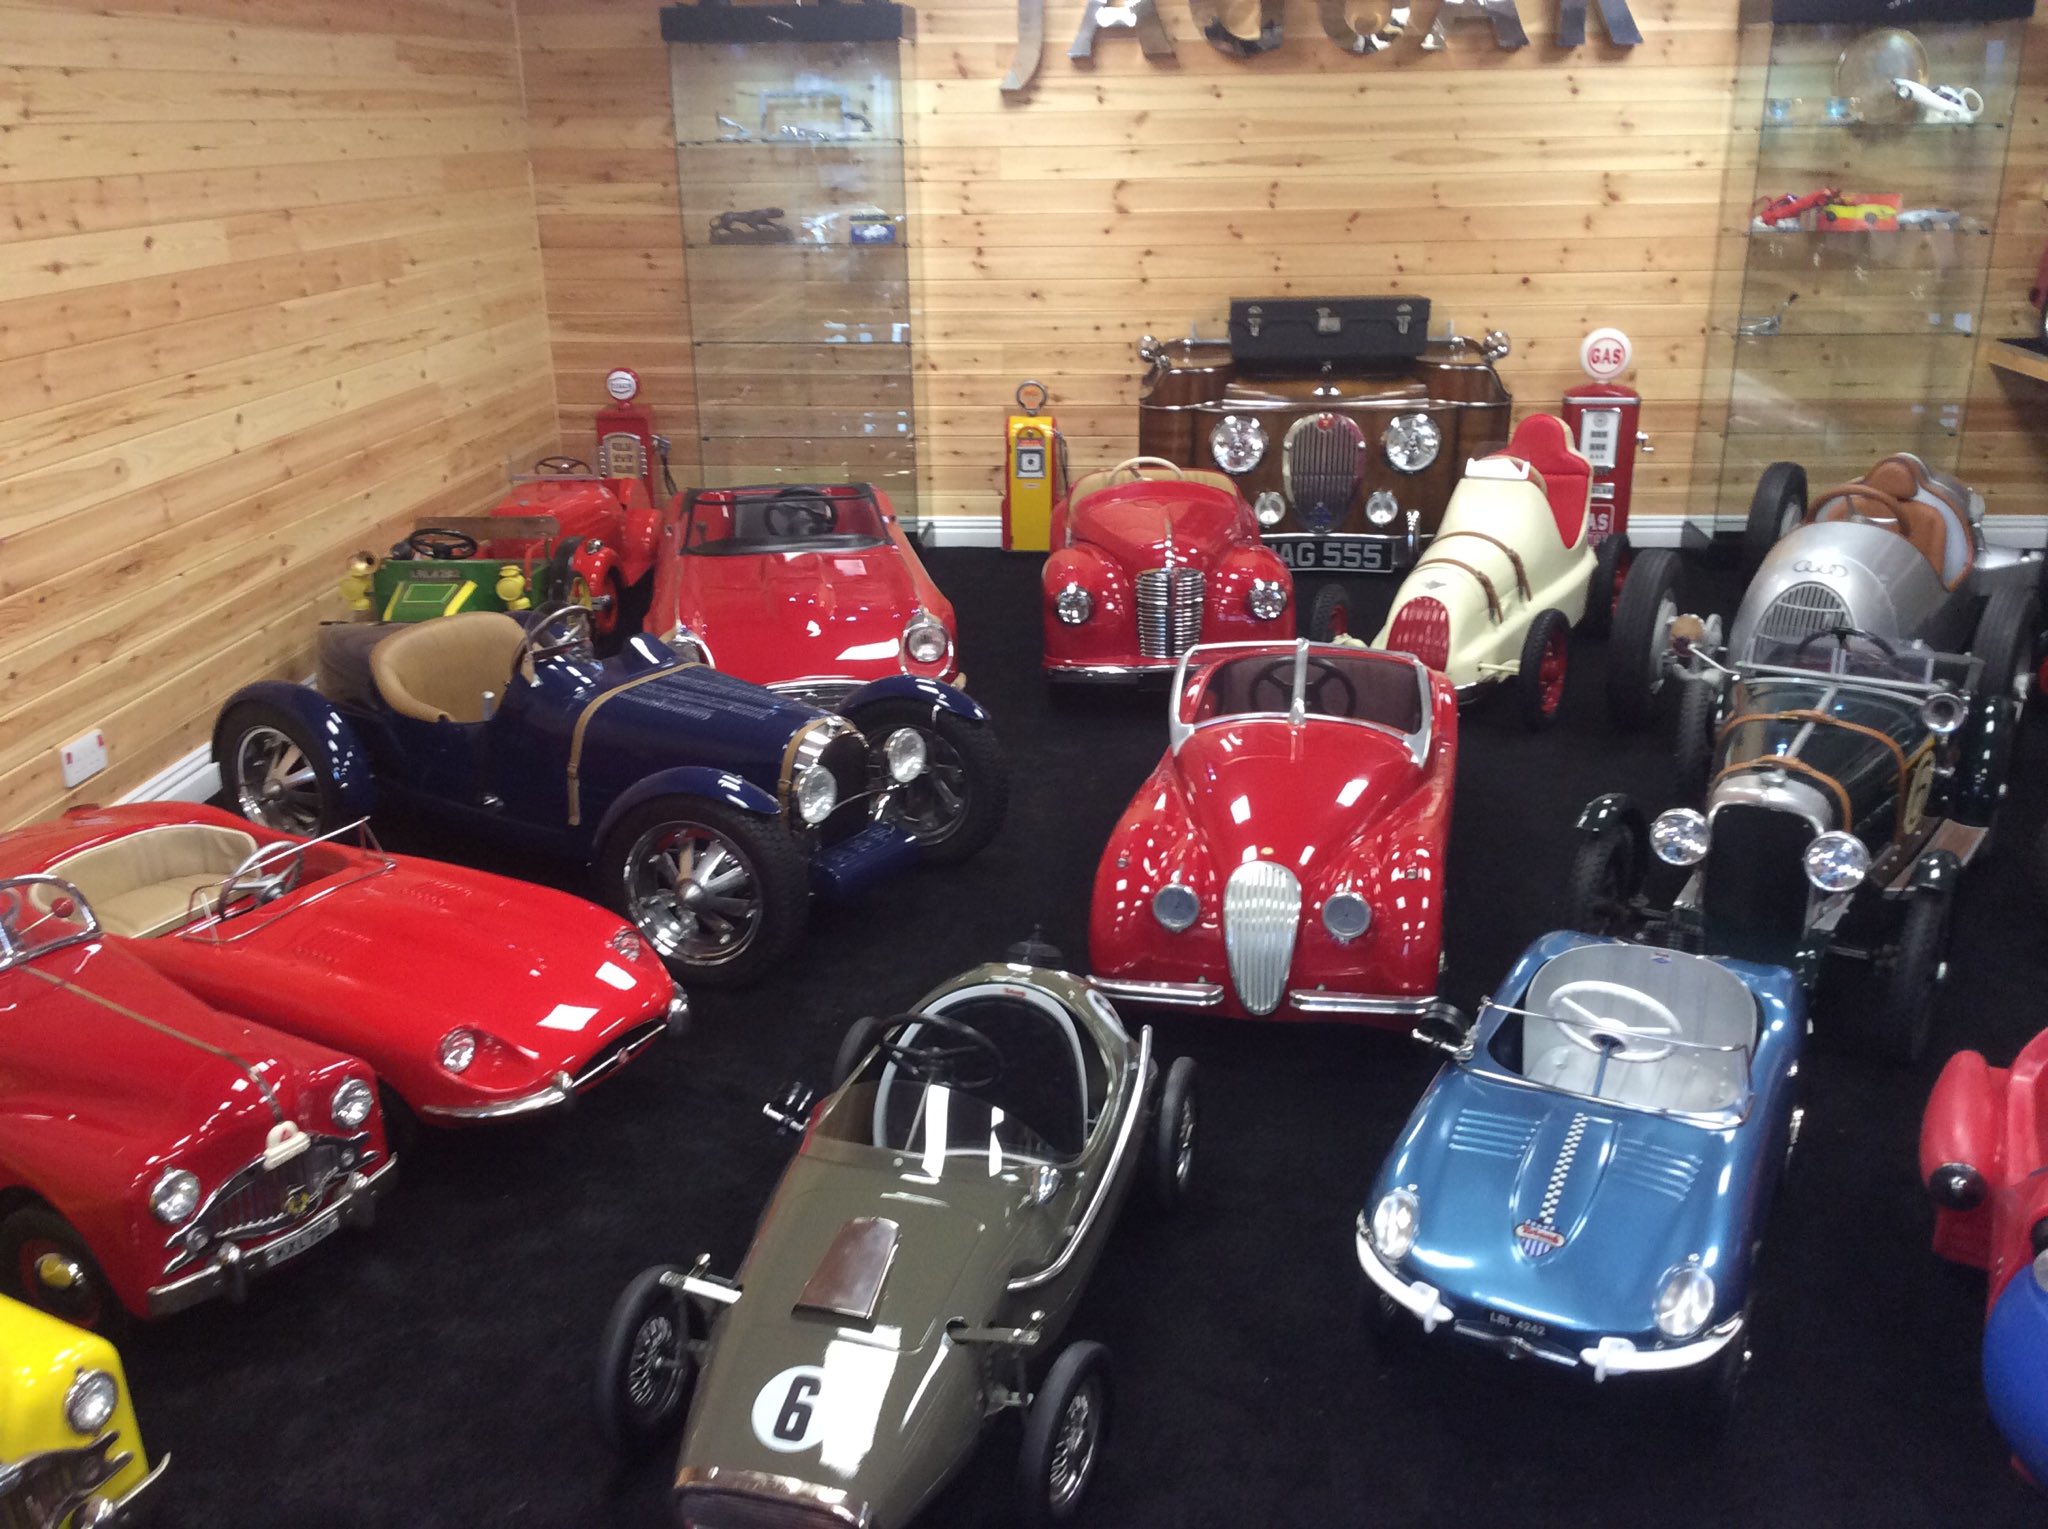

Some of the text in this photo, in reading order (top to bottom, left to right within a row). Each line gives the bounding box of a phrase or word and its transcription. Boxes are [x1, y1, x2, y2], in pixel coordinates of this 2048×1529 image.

[1591, 348, 1621, 364] GAS
[1588, 513, 1609, 531] AS
[1271, 542, 1382, 569] AG 555
[773, 1374, 821, 1441] 6
